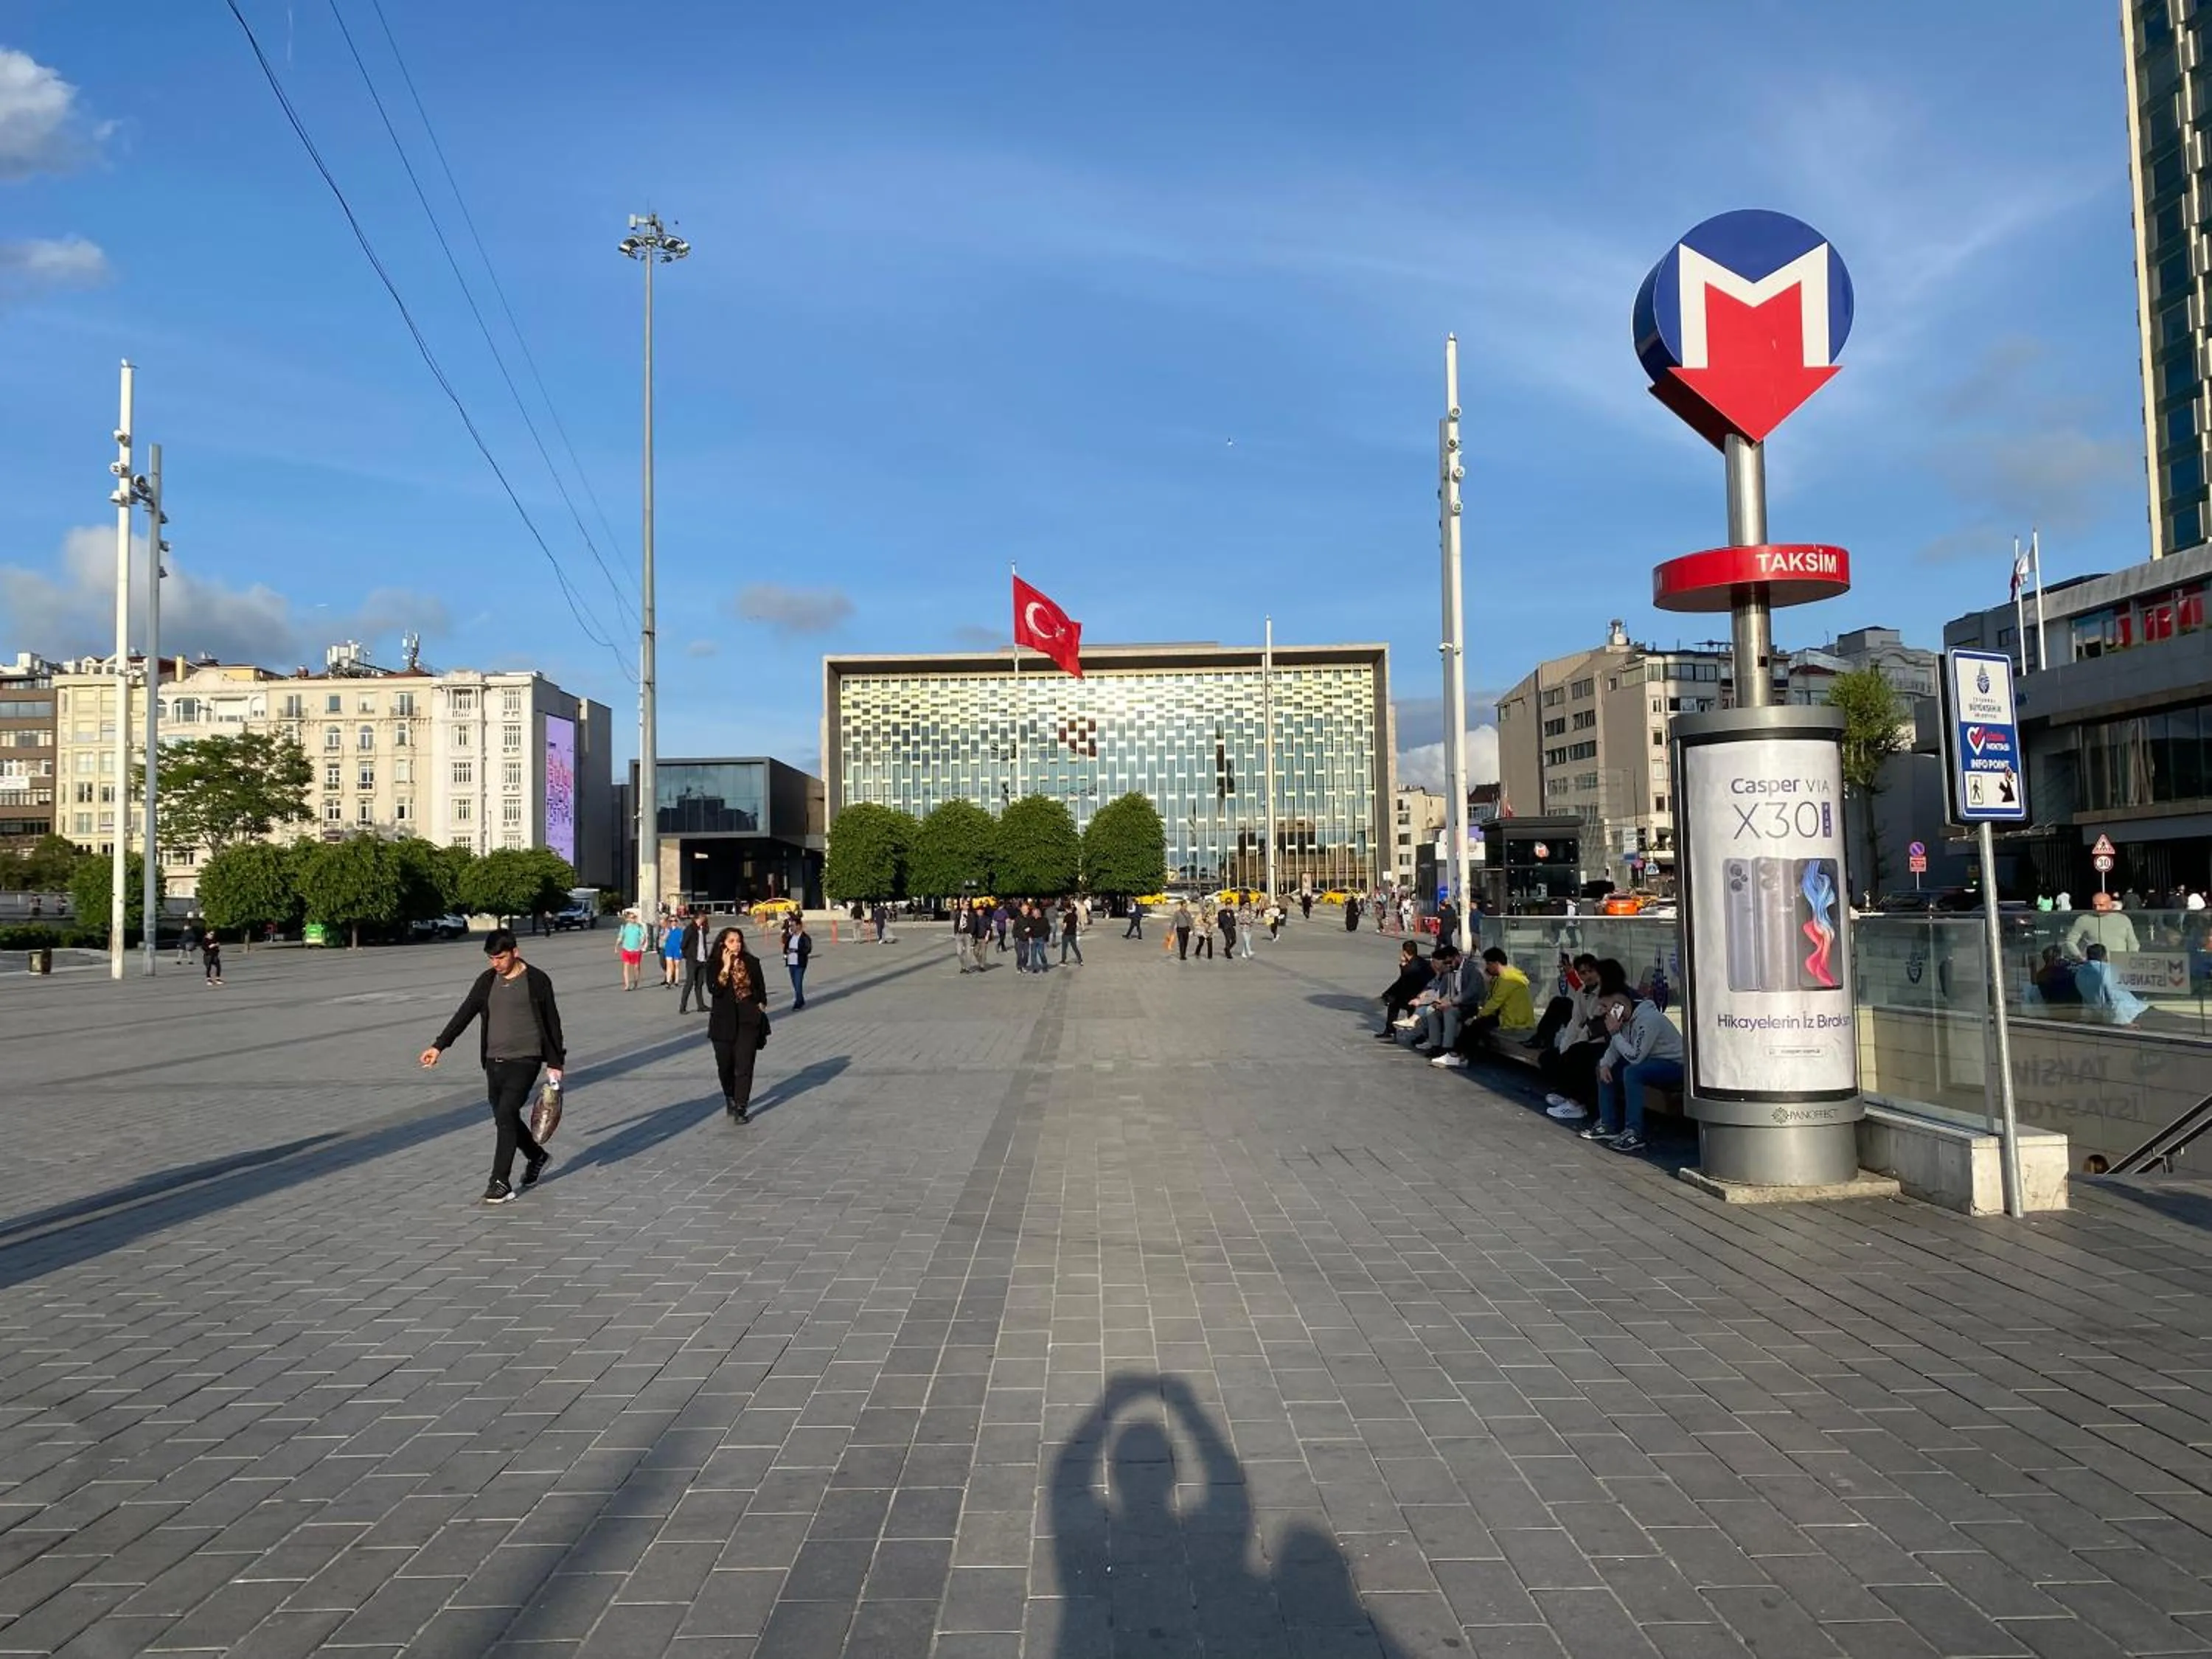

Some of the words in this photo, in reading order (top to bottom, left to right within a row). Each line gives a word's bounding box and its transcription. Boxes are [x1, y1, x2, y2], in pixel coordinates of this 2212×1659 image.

[1756, 549, 1837, 574] TAKSİM
[1971, 759, 1989, 769] INFO
[1731, 778, 1801, 797] Casper
[1806, 779, 1831, 793] VIA
[1733, 801, 1819, 840] X30
[2098, 858, 2110, 868] 30
[1717, 1014, 1801, 1032] Hikayelerin
[1803, 1011, 1815, 1029] İz
